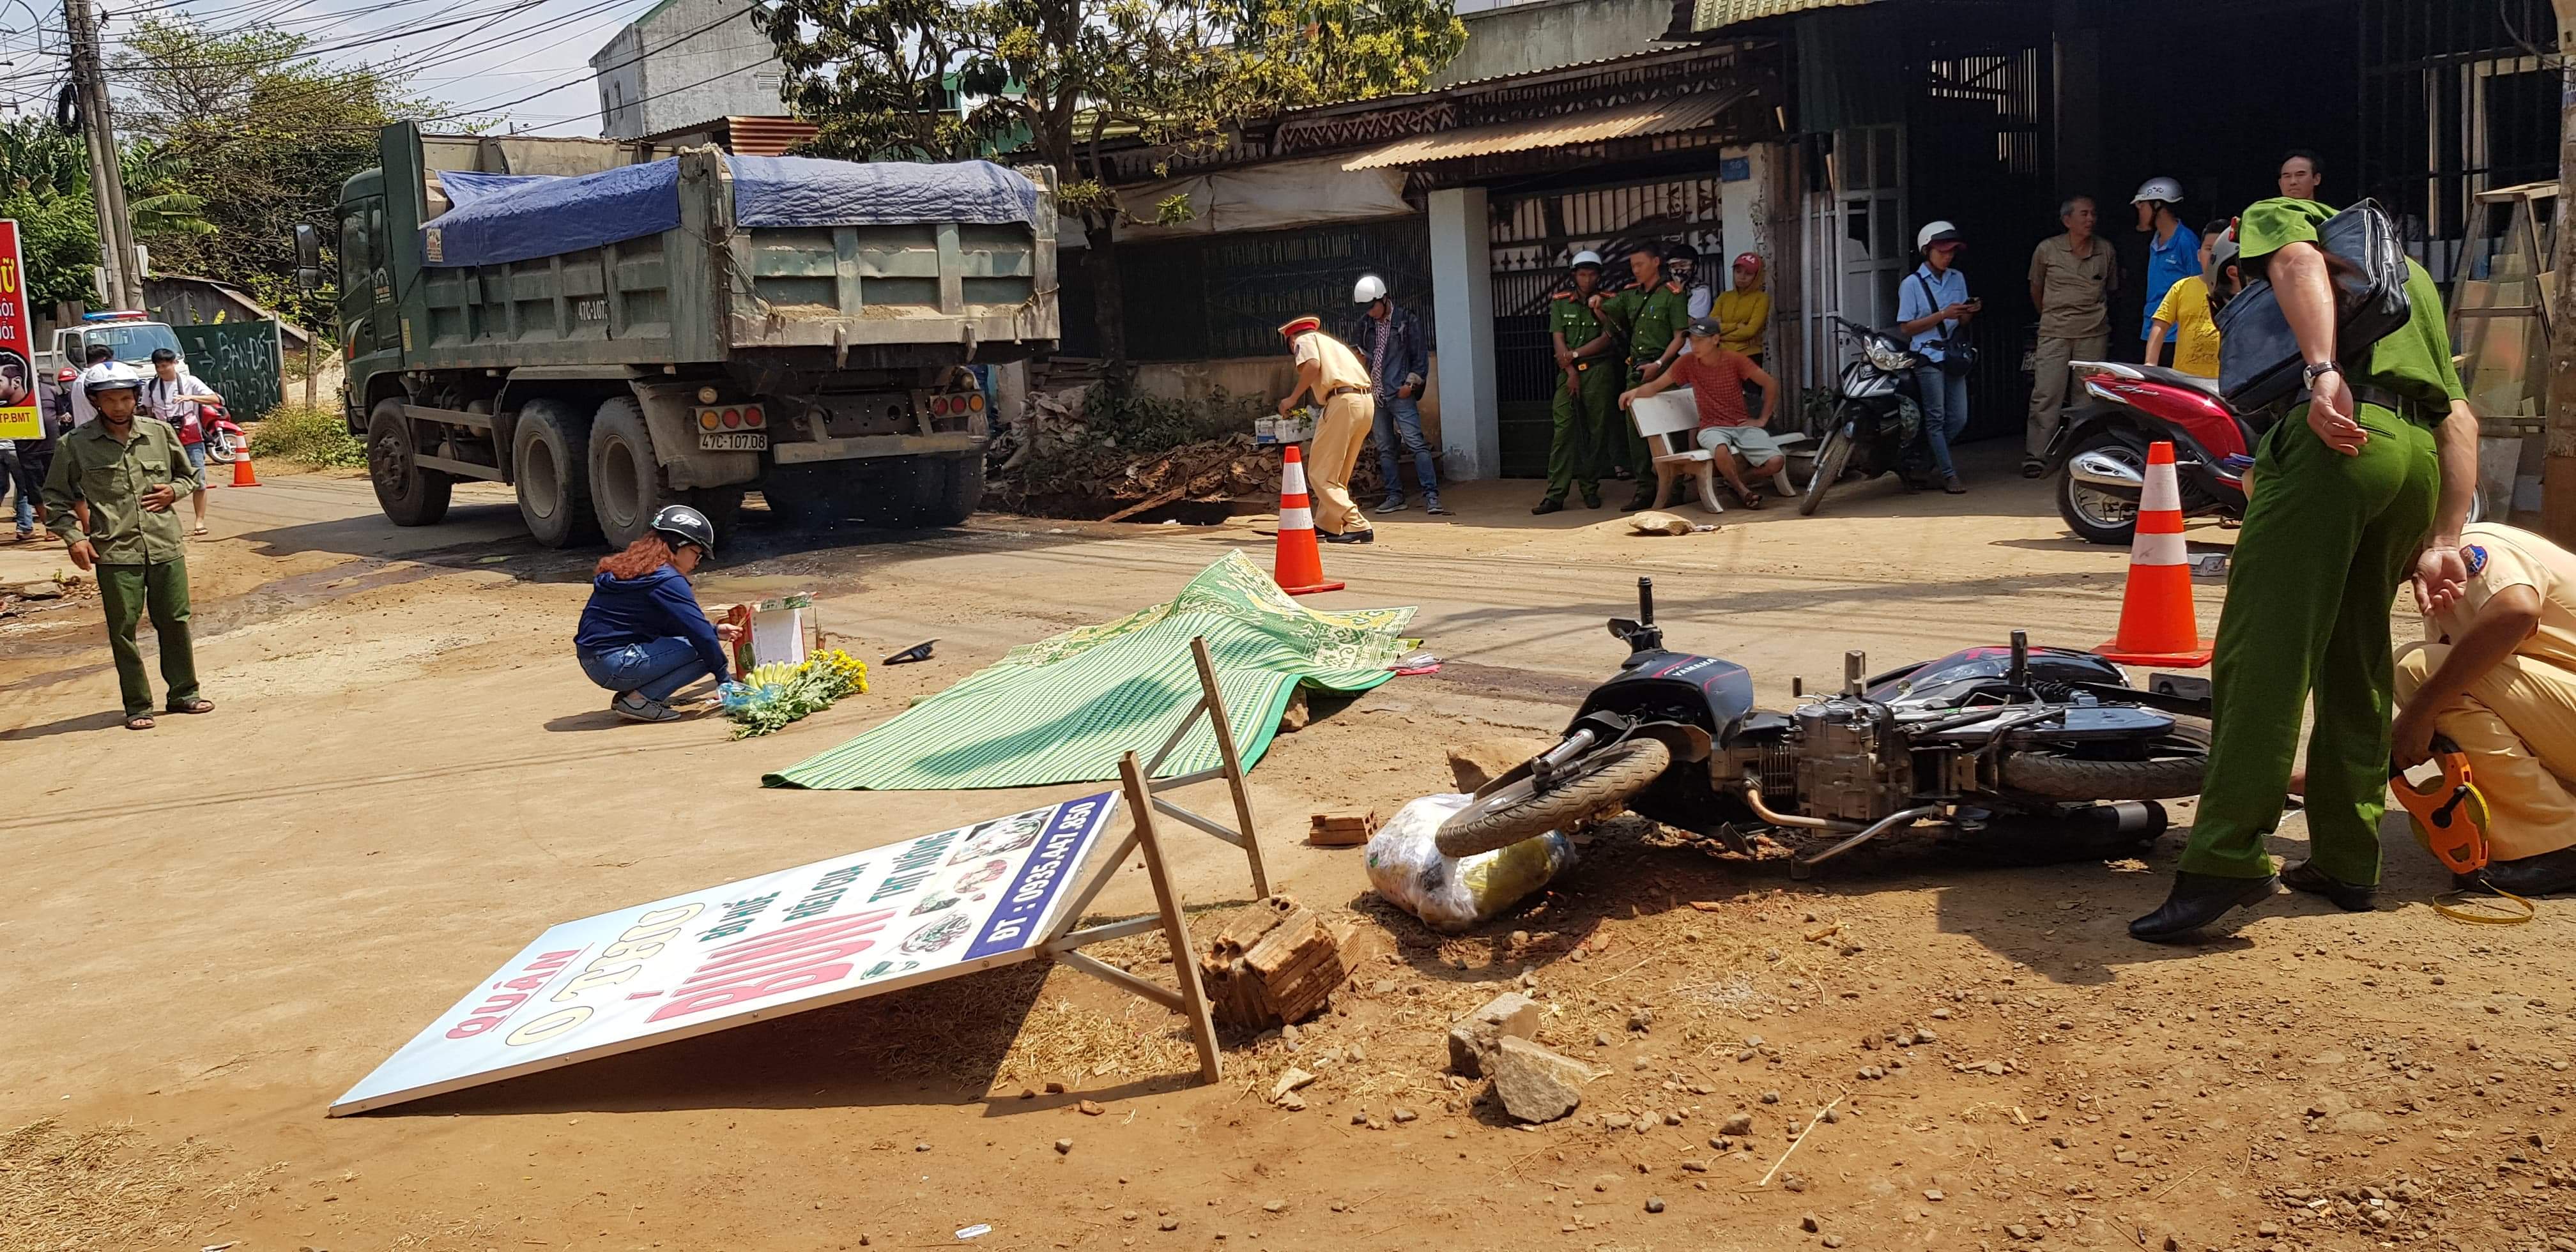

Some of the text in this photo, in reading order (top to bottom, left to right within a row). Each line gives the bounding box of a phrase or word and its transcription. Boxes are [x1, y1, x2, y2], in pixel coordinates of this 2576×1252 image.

[0, 257, 15, 293] Ữ
[0, 298, 15, 321] ỘI
[703, 435, 765, 448] 47C-107.08
[1671, 658, 1717, 676] YAMAHA
[781, 862, 871, 922] RIÊU CUA
[866, 830, 961, 903] THỊT NƯỚNG
[986, 917, 1027, 943] ĐT
[1013, 801, 1096, 903] 0935.447.850
[694, 890, 782, 942] BÒ HUẾ
[625, 910, 896, 1023] BÚN
[446, 949, 581, 1039] QUÁN
[505, 1006, 594, 1046] O
